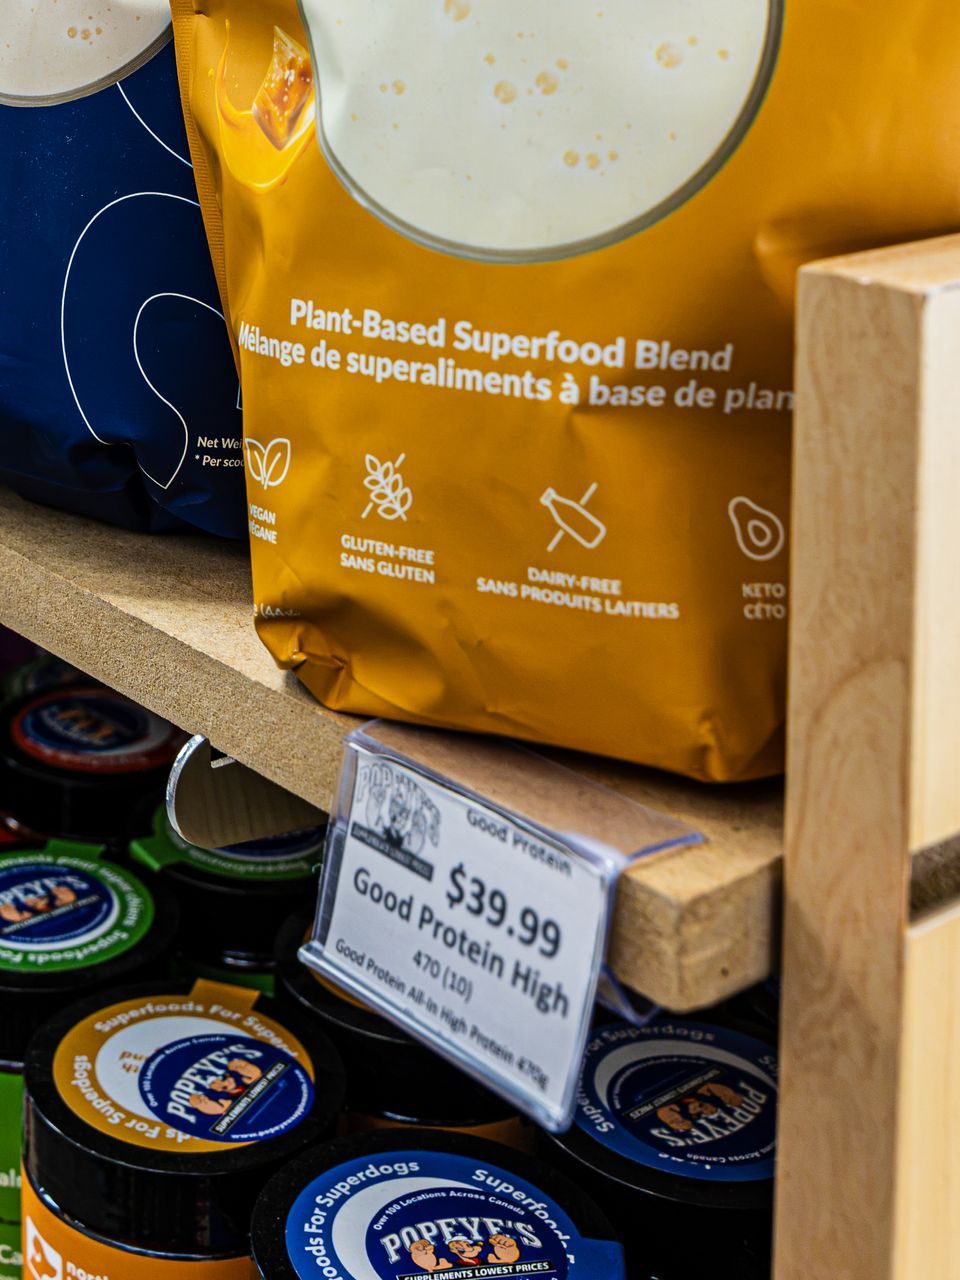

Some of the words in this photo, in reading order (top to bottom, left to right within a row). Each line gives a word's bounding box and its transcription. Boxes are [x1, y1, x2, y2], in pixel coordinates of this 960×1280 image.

[289, 299, 446, 349] Plant-Based
[453, 326, 626, 370] Superfood
[634, 338, 735, 373] Blend
[238, 321, 306, 367] Mélange
[310, 341, 342, 370] de
[346, 350, 552, 403] superaliments
[559, 372, 580, 404] à
[589, 376, 666, 409] base
[674, 379, 716, 409] de
[197, 436, 219, 449] Net
[202, 455, 222, 468] Per
[340, 533, 435, 566] GLUTEN-FREE
[340, 553, 375, 576] SANS
[377, 558, 436, 586] GLUTEN
[476, 577, 518, 599] SANS
[520, 582, 603, 615] PRODUITS
[604, 597, 680, 621] LAITIERS
[527, 566, 622, 597] DAIRY-FREE
[742, 582, 786, 600] KETO
[742, 600, 787, 621] CÉTO
[465, 807, 508, 844] Good
[510, 831, 573, 877] Protein
[446, 862, 562, 959] $39.99
[352, 867, 414, 922] Good
[418, 908, 505, 978] Protein
[511, 956, 570, 1019] High
[412, 949, 442, 979] 470
[442, 967, 473, 1004] (10)
[93, 1001, 205, 1034] Superfoods
[208, 1004, 242, 1021] For
[335, 938, 365, 970] Good
[365, 956, 407, 997] Protein
[407, 984, 439, 1017] All-in
[440, 1004, 469, 1037] High
[470, 1022, 515, 1064] Protein
[70, 1054, 126, 1126] Superdogs
[165, 1042, 265, 1126] POPEYE'S
[315, 1160, 421, 1208] Superdogs
[303, 1207, 328, 1234] For
[373, 1216, 389, 1232] Over
[385, 1202, 402, 1217] 100
[399, 1191, 448, 1208] Locations
[449, 1190, 486, 1201] Across
[488, 1195, 526, 1217] Canada
[379, 1215, 543, 1265] POPEYE'S
[474, 1264, 514, 1277] LOWEST
[515, 1261, 550, 1273] PRICES
